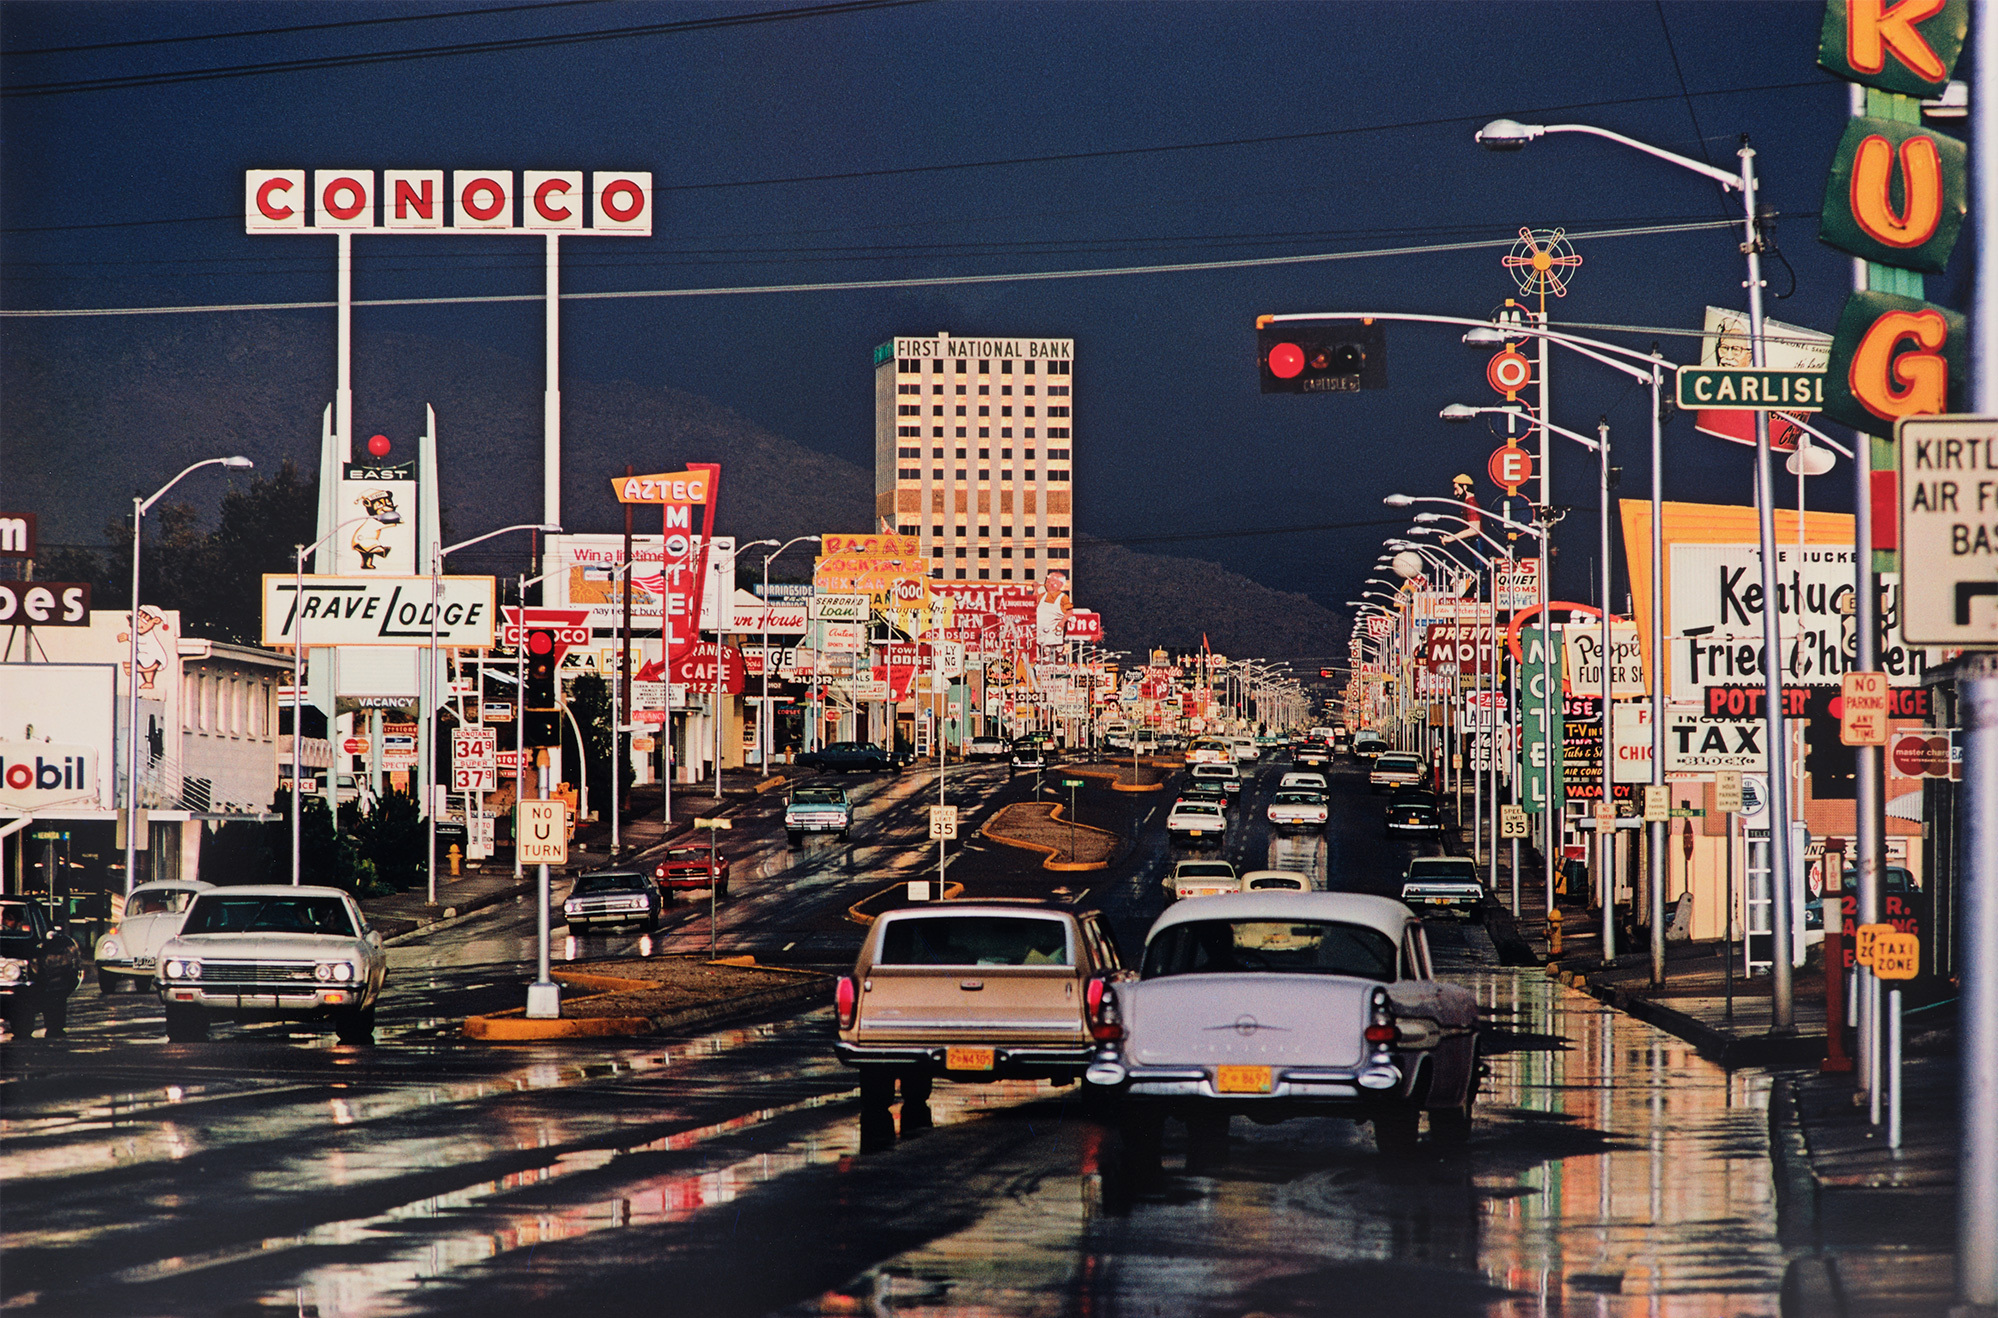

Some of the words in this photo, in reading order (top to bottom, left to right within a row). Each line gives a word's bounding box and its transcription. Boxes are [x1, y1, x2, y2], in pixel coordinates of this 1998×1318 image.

[256, 177, 645, 222] CONOCO
[899, 341, 940, 356] FIRST
[948, 341, 1022, 357] NATIONAL
[1030, 342, 1070, 358] BANK
[1916, 439, 1998, 470] KIRTL
[349, 470, 408, 480] EAST
[624, 478, 704, 500] AZTEC
[1912, 482, 1959, 512] AIR
[1978, 482, 1998, 512] F
[825, 537, 917, 556] BACA'S
[574, 548, 601, 561] Win
[604, 551, 613, 562] a
[616, 549, 665, 562] lietime
[1756, 551, 1787, 562] TE
[820, 560, 924, 573] COCKTAILS
[666, 506, 689, 645] MOTEL
[1498, 575, 1537, 585] QUIET
[756, 585, 814, 596] MRNINGSIDE
[1720, 565, 1899, 634] Kentucy
[757, 608, 804, 630] House
[925, 631, 975, 640] RODSDE
[985, 639, 1024, 650] MOTL
[1432, 644, 1498, 661] MOT
[1682, 626, 1768, 684] Frie
[1789, 630, 1927, 679] Chen
[884, 655, 931, 665] LODGE
[681, 663, 731, 680] CAFE
[684, 682, 729, 693] PIZZA
[1855, 678, 1876, 692] NO
[358, 698, 415, 707] VACANCY
[1709, 688, 1811, 715] POTER
[1846, 696, 1884, 710] PARKING
[1528, 640, 1557, 801] MOTEL
[1856, 715, 1874, 724] ANY
[1672, 726, 1761, 754] TAX
[1856, 730, 1875, 739] TIME
[0, 757, 84, 790] obil
[1564, 767, 1579, 776] AIR
[1566, 785, 1630, 798] VACACY
[532, 808, 552, 819] NO
[534, 823, 550, 840] U
[934, 823, 953, 835] 35
[1505, 822, 1525, 834] 35
[523, 845, 561, 856] TURN
[1829, 855, 1838, 888] FIRE
[1879, 943, 1913, 955] TAXI
[1879, 959, 1914, 971] ZONE
